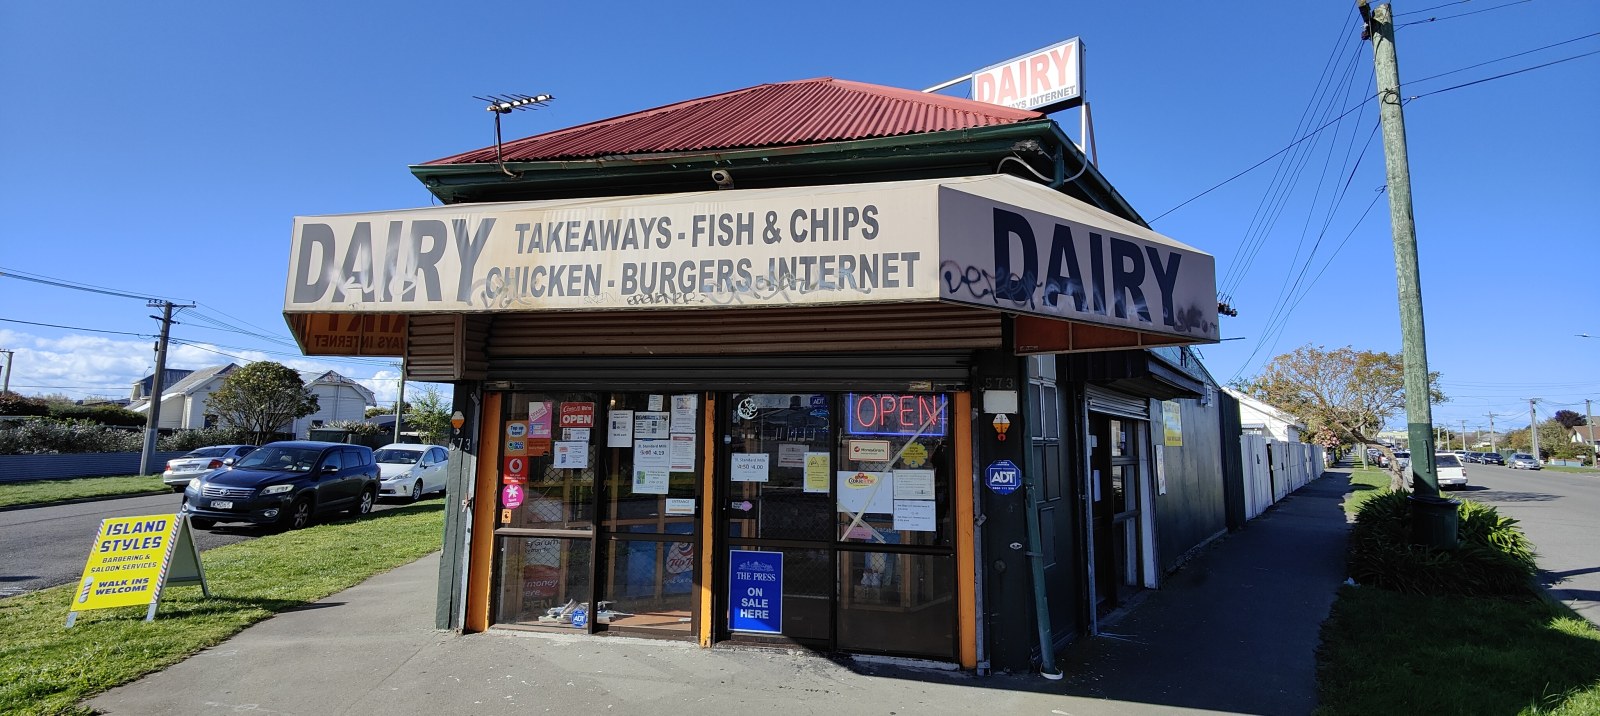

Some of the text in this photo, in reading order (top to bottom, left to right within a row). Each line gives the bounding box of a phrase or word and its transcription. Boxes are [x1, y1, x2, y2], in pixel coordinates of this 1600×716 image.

[977, 44, 1073, 104] DAIRY
[1030, 85, 1075, 106] INTERNET
[515, 216, 672, 254] TAKEAWAYS
[692, 212, 754, 247] FISH
[763, 210, 782, 244] &
[790, 205, 880, 243] CHIPS
[293, 218, 497, 303] DAIRY
[993, 207, 1182, 327] DAIRY
[486, 264, 602, 299] CHICKEN
[621, 257, 752, 295] BURGERS
[769, 252, 920, 291] INTERNET
[985, 378, 1013, 389] 573
[857, 395, 937, 427] OPEN
[562, 414, 592, 424] OPEN
[449, 437, 470, 451] 573
[991, 471, 1016, 484] ADT
[106, 520, 167, 536] ISLAND
[100, 536, 163, 553] STYLES
[102, 554, 144, 564] BARBERING
[90, 562, 157, 574] SALOON SERVICES
[98, 577, 149, 588] WALK INS
[736, 571, 776, 581] THE PRESS
[95, 585, 148, 596] WELCOME
[747, 587, 762, 597] ON
[741, 598, 768, 608] SALE
[740, 608, 769, 619] HERE
